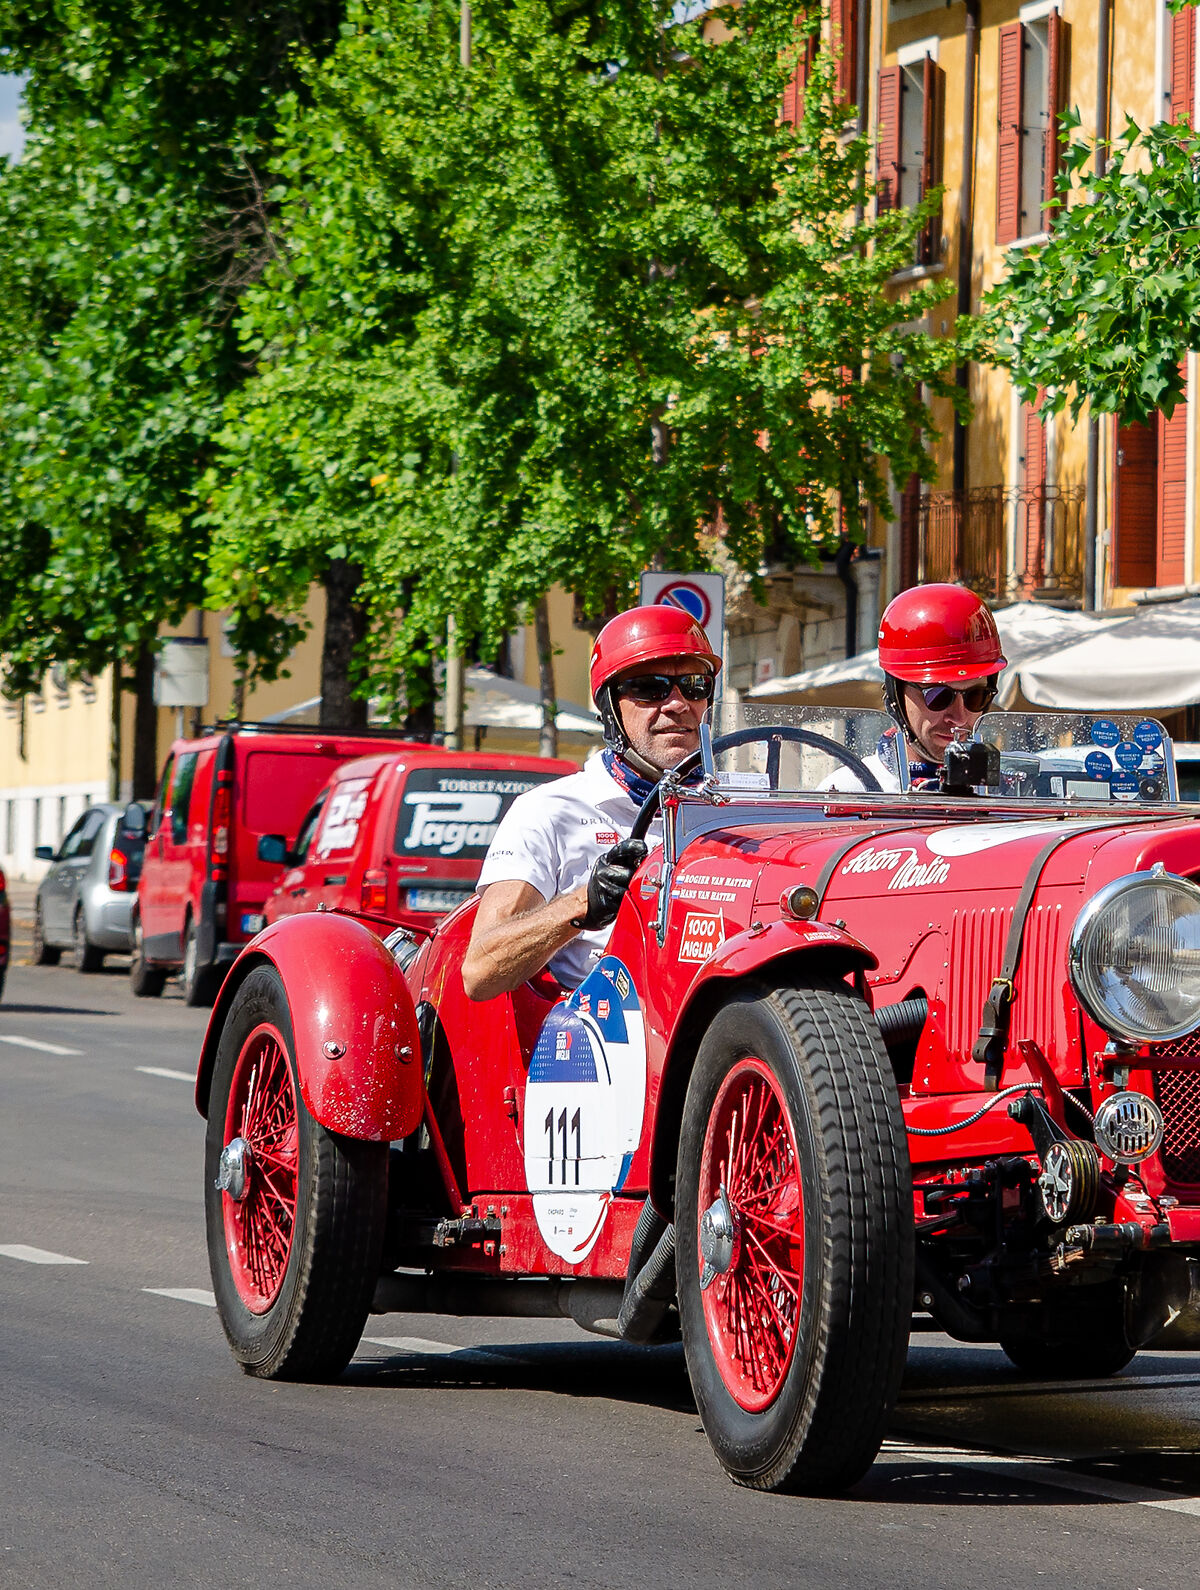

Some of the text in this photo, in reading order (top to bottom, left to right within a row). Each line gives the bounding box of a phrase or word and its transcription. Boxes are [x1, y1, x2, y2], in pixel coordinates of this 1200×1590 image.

[841, 847, 951, 890] Aston Martin
[683, 875, 753, 889] ROGIER VAN HATTEM
[680, 889, 737, 902] HANS VAN HATTEM
[688, 919, 716, 937] 1000
[681, 941, 714, 959] MIGLIA
[545, 1107, 581, 1185] 111
